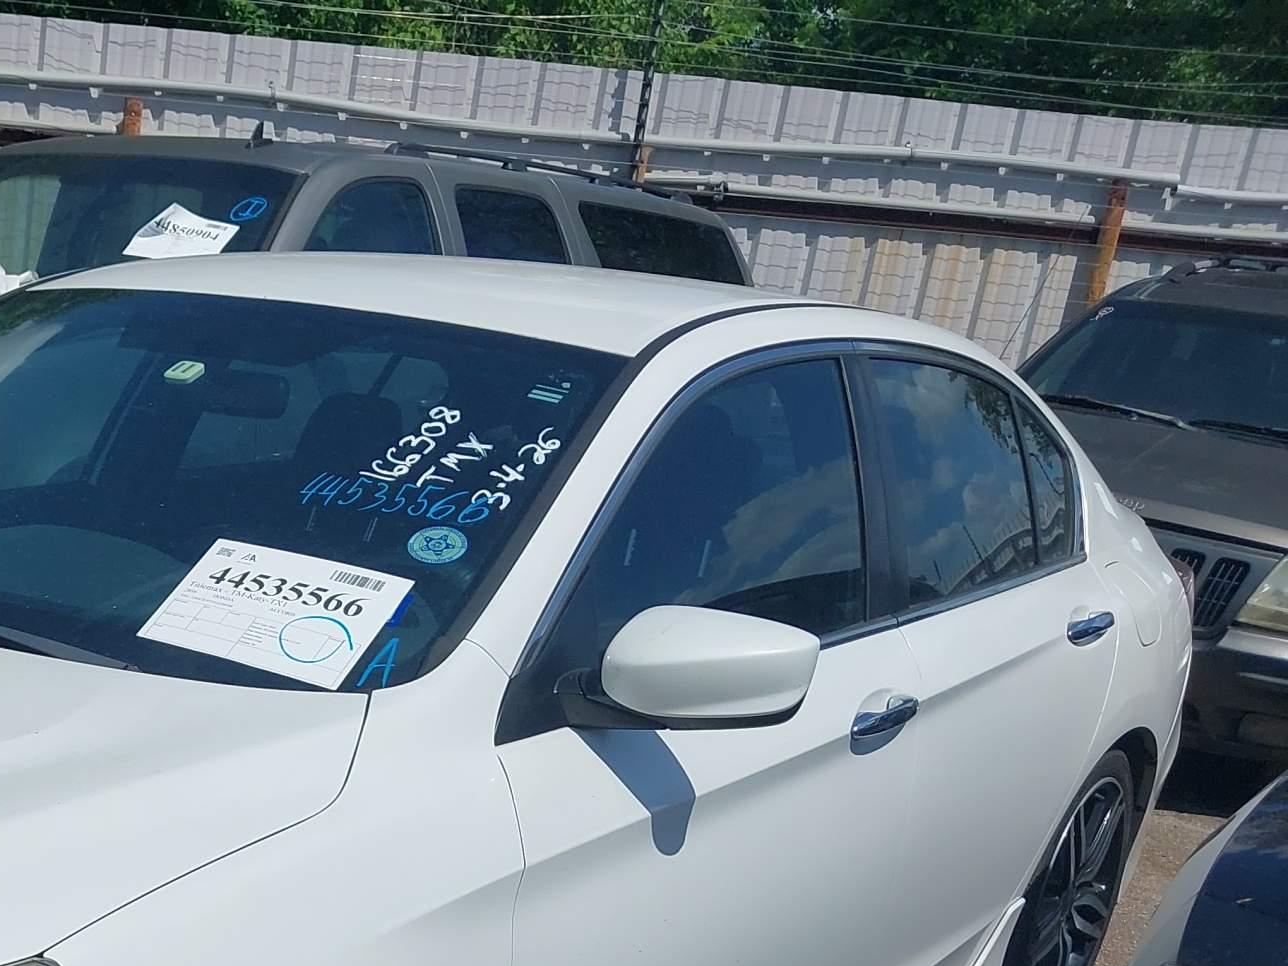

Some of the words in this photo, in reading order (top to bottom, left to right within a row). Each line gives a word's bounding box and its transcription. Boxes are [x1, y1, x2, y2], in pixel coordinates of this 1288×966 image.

[359, 406, 461, 482] 166308
[300, 472, 494, 523] 44535566
[208, 566, 370, 617] 44535566
[355, 637, 396, 688] A
